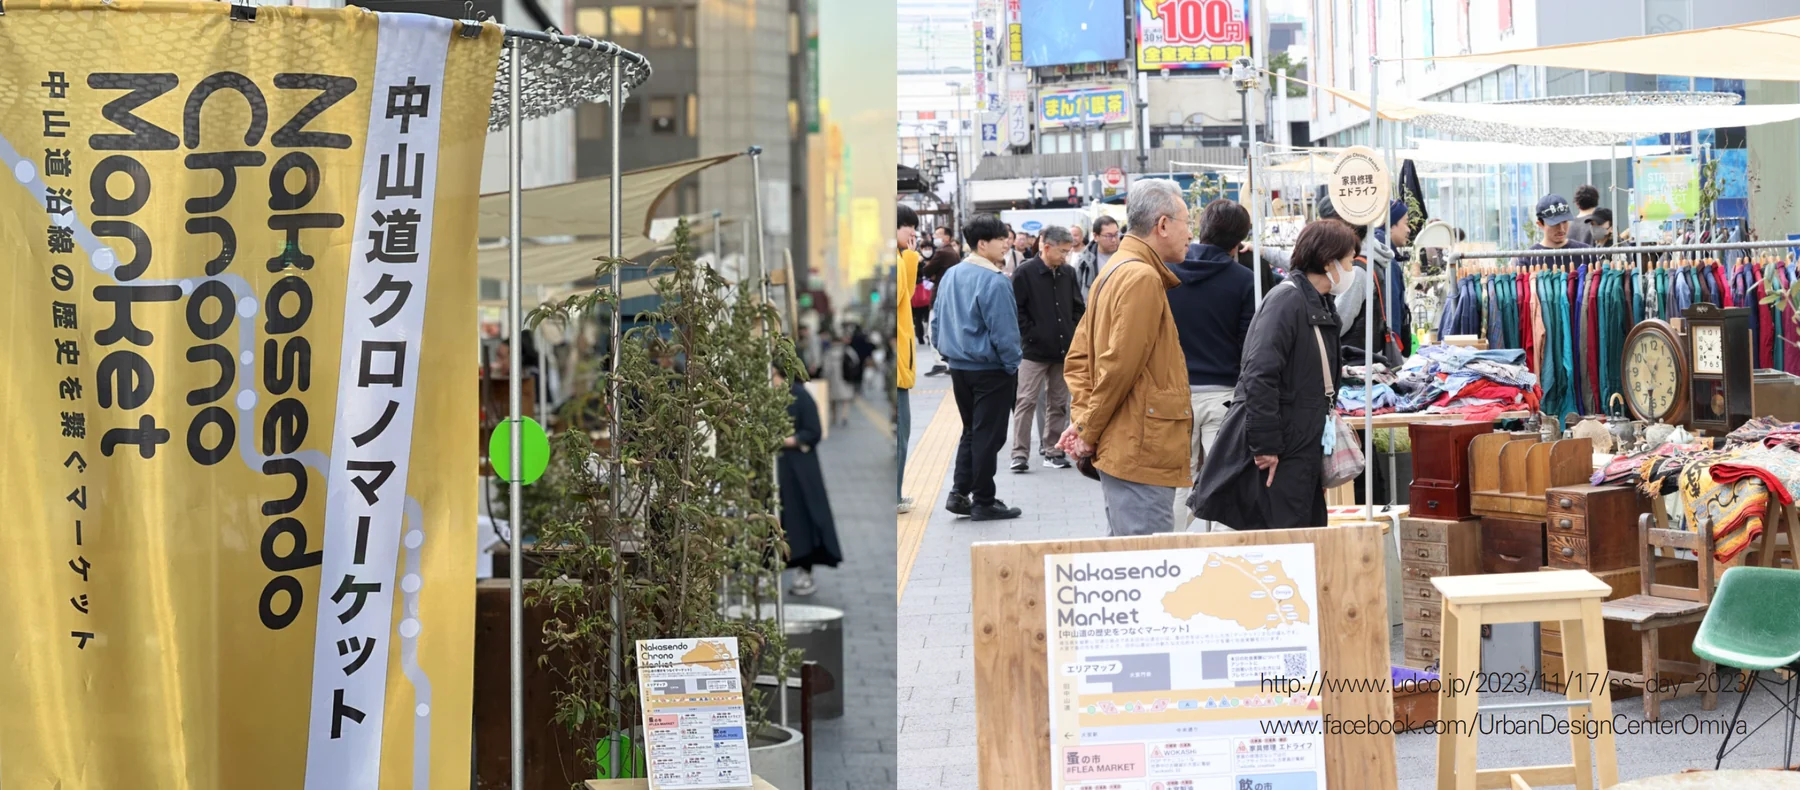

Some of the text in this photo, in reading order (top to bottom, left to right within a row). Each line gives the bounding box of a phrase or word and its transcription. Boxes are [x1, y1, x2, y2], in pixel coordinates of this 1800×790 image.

[1012, 104, 1026, 143] オガワ
[1341, 174, 1374, 186] 家具修理
[1339, 186, 1378, 197] エドライフ
[87, 72, 183, 459] Market
[183, 71, 268, 466] Chrono
[259, 72, 358, 630] Nakasendo
[1641, 343, 1647, 354] 11
[1650, 341, 1658, 351] 12
[41, 71, 95, 650] 中山道沿線の歴史を繋ぐマーケット
[1634, 353, 1642, 363] 10
[1667, 357, 1672, 367] 2
[1632, 367, 1639, 377] 9
[1670, 372, 1675, 382] 3
[1635, 382, 1642, 392] 8
[1667, 387, 1673, 396] 4
[1642, 394, 1648, 404] 7
[1660, 396, 1666, 406] 5
[330, 76, 431, 739] 中山道クロノマーケット
[1056, 559, 1181, 583] Nakasendo
[1057, 585, 1141, 605] Chrono
[1058, 606, 1139, 628] Market
[641, 642, 688, 651] Nakasendo
[641, 651, 673, 660] Chrono
[1067, 663, 1116, 674] エリアマップ
[1279, 742, 1313, 750] エドライフ
[1067, 751, 1101, 765] 蚤の市
[1067, 763, 1135, 774] #FLEA MARKET
